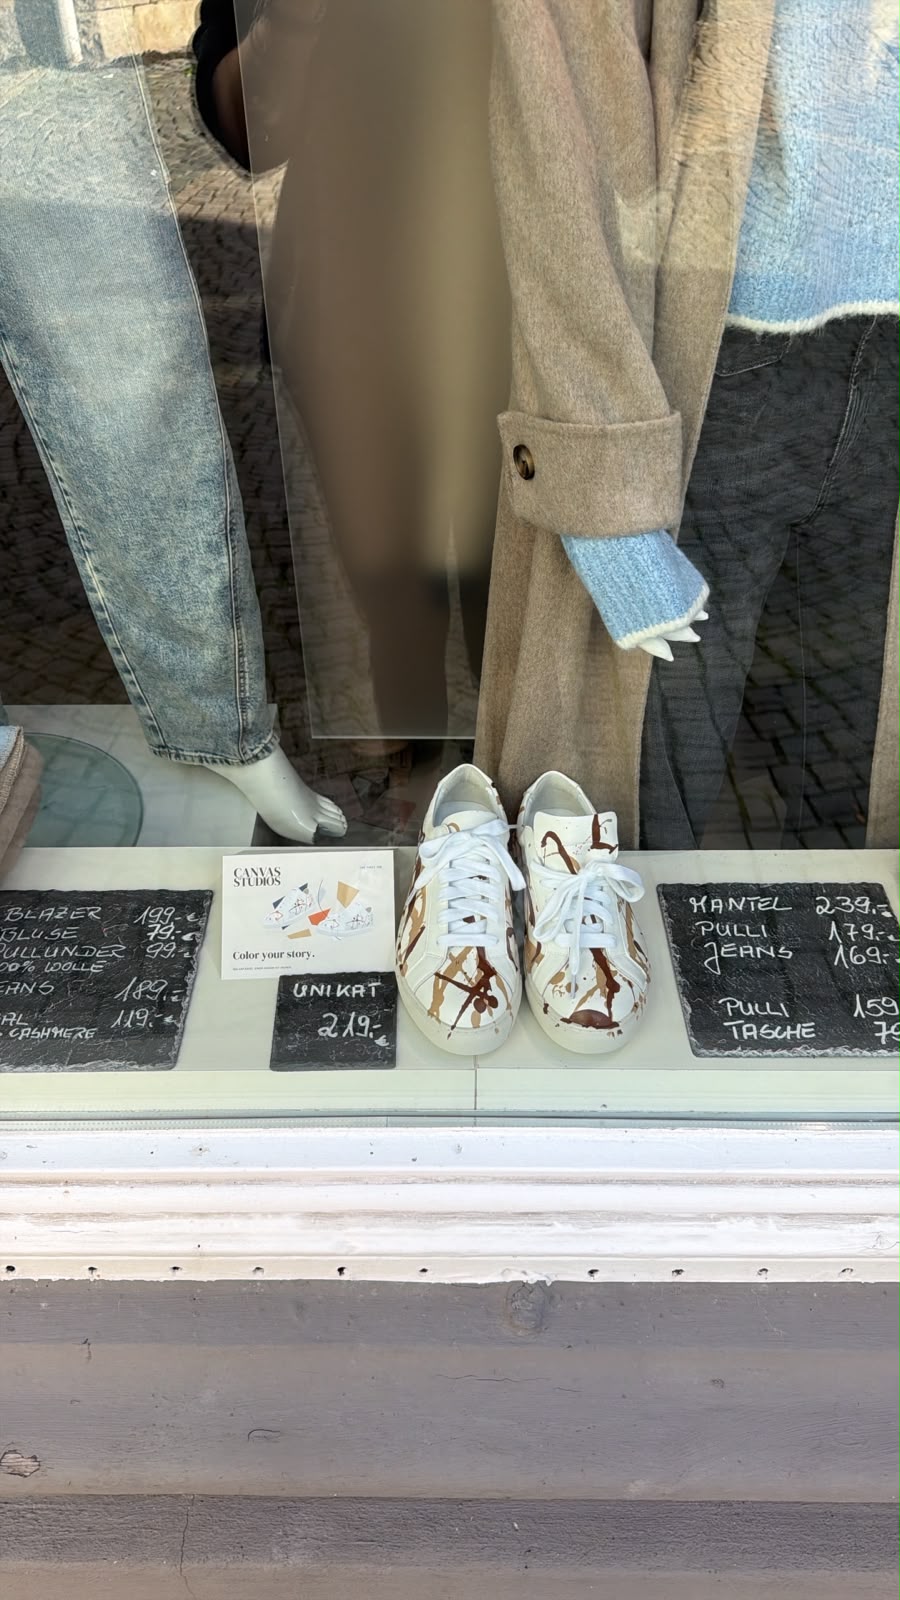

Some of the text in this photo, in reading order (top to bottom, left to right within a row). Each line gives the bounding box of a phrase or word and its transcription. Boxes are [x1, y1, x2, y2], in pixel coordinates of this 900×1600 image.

[233, 867, 281, 878] CANVAS
[233, 877, 281, 887] STUDIOS
[689, 896, 792, 913] MANTEL
[4, 906, 102, 922] BLAZER
[695, 921, 768, 938] PULLI
[232, 950, 316, 962] Color your story.
[703, 942, 793, 975] JEANS
[44, 960, 107, 973] WOLLE
[293, 982, 382, 998] UNIKAT
[718, 997, 790, 1018] PULLI
[8, 1026, 98, 1040] CASHMERE
[723, 1020, 816, 1040] TASCHE
